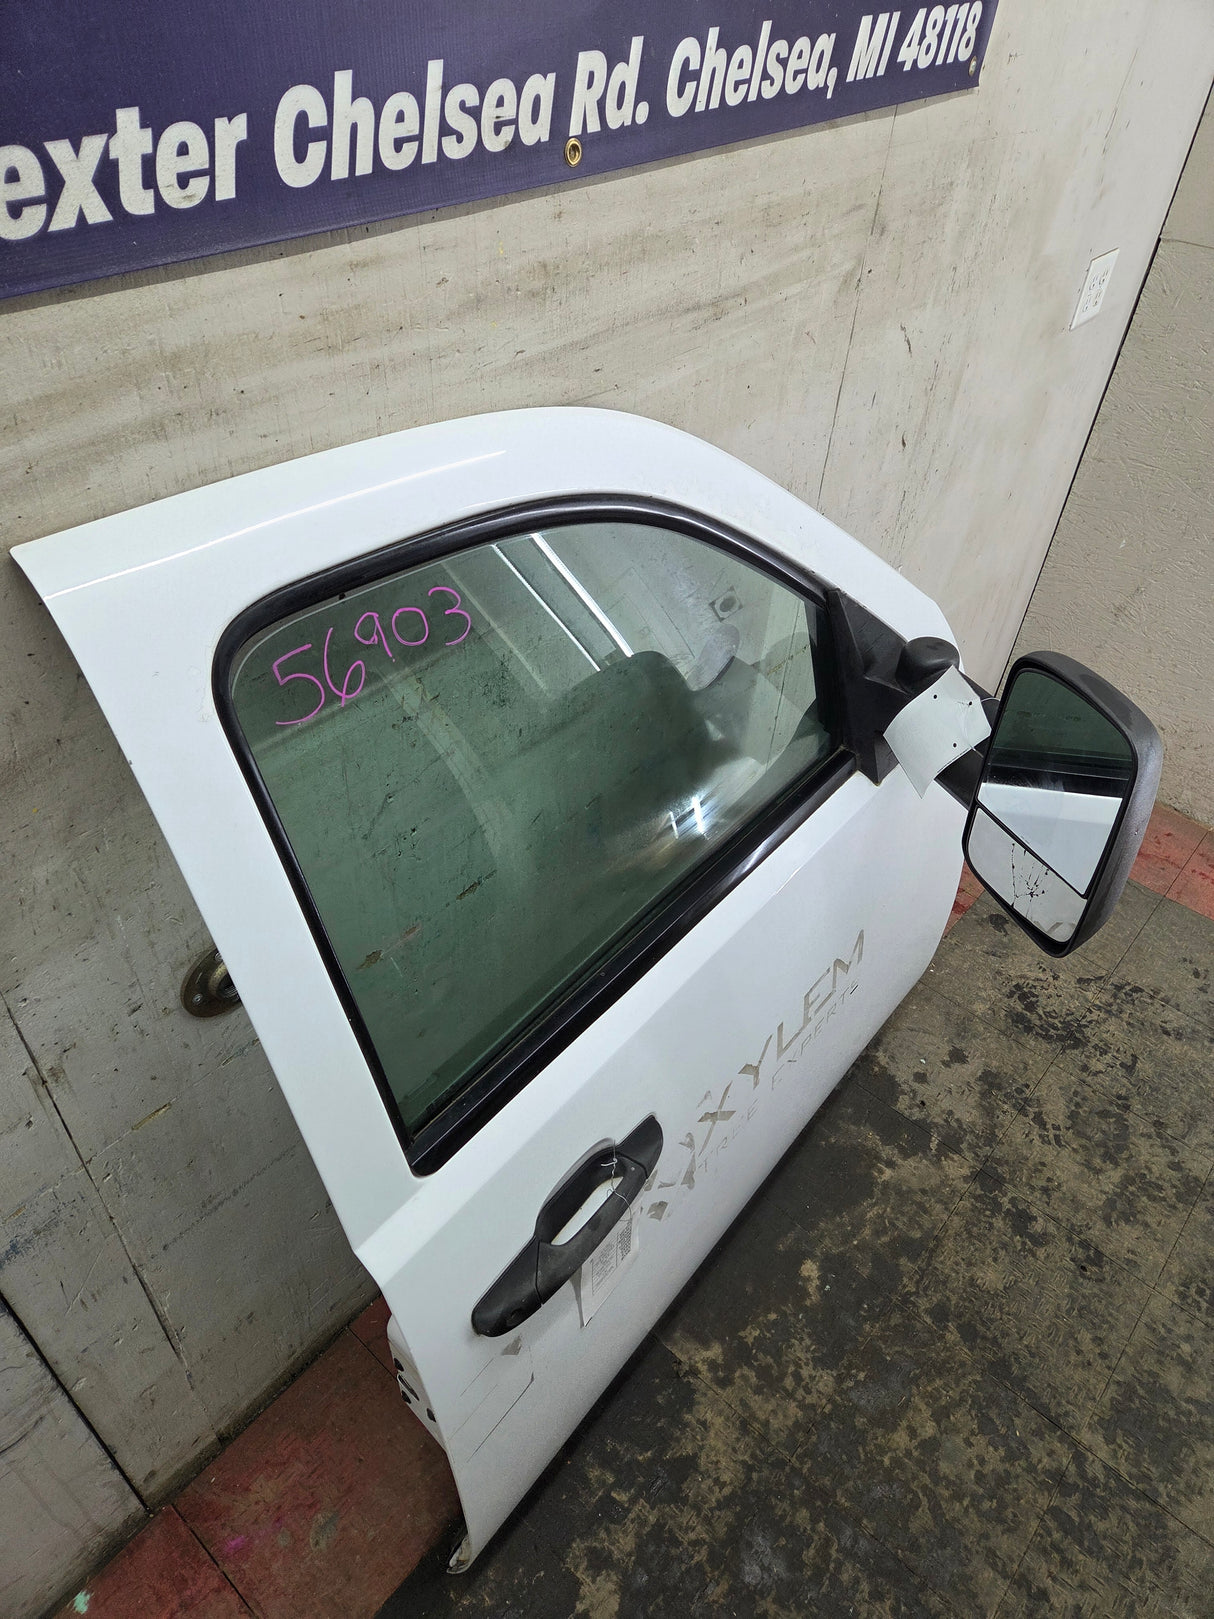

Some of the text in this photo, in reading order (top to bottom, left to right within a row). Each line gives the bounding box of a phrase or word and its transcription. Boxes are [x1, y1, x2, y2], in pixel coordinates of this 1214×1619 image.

[0, 0, 983, 241] exter Chelsea Rd. Chelsea, MI 48118
[272, 586, 472, 725] 56903
[697, 929, 865, 1158] XYLEM
